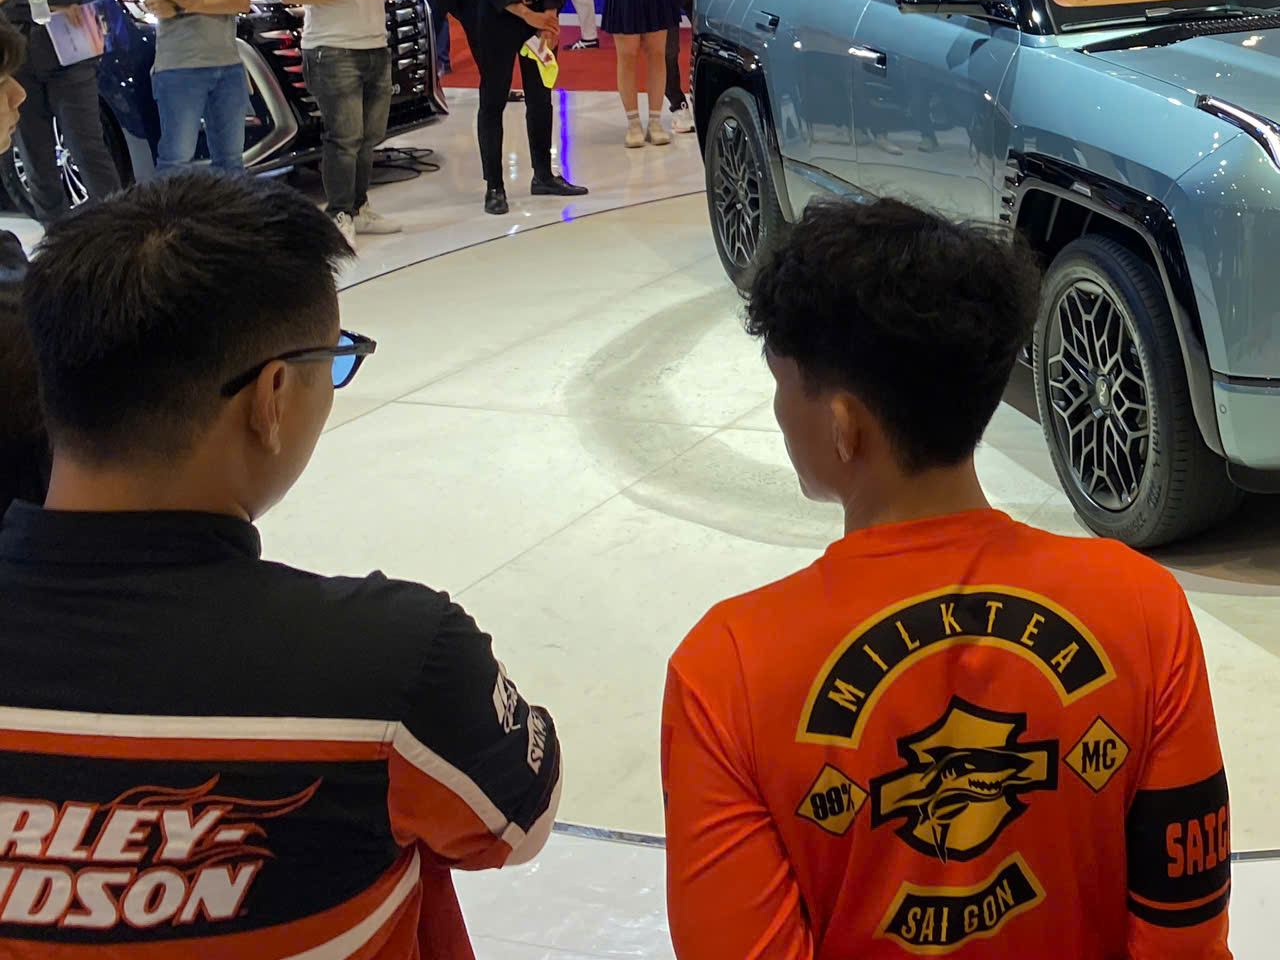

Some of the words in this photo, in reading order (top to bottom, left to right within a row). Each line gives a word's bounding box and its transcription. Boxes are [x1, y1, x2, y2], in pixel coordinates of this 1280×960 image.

[1081, 738, 1117, 773] MC
[1166, 805, 1231, 878] SAIG
[901, 906, 950, 942] SAI
[963, 880, 1015, 933] GON
